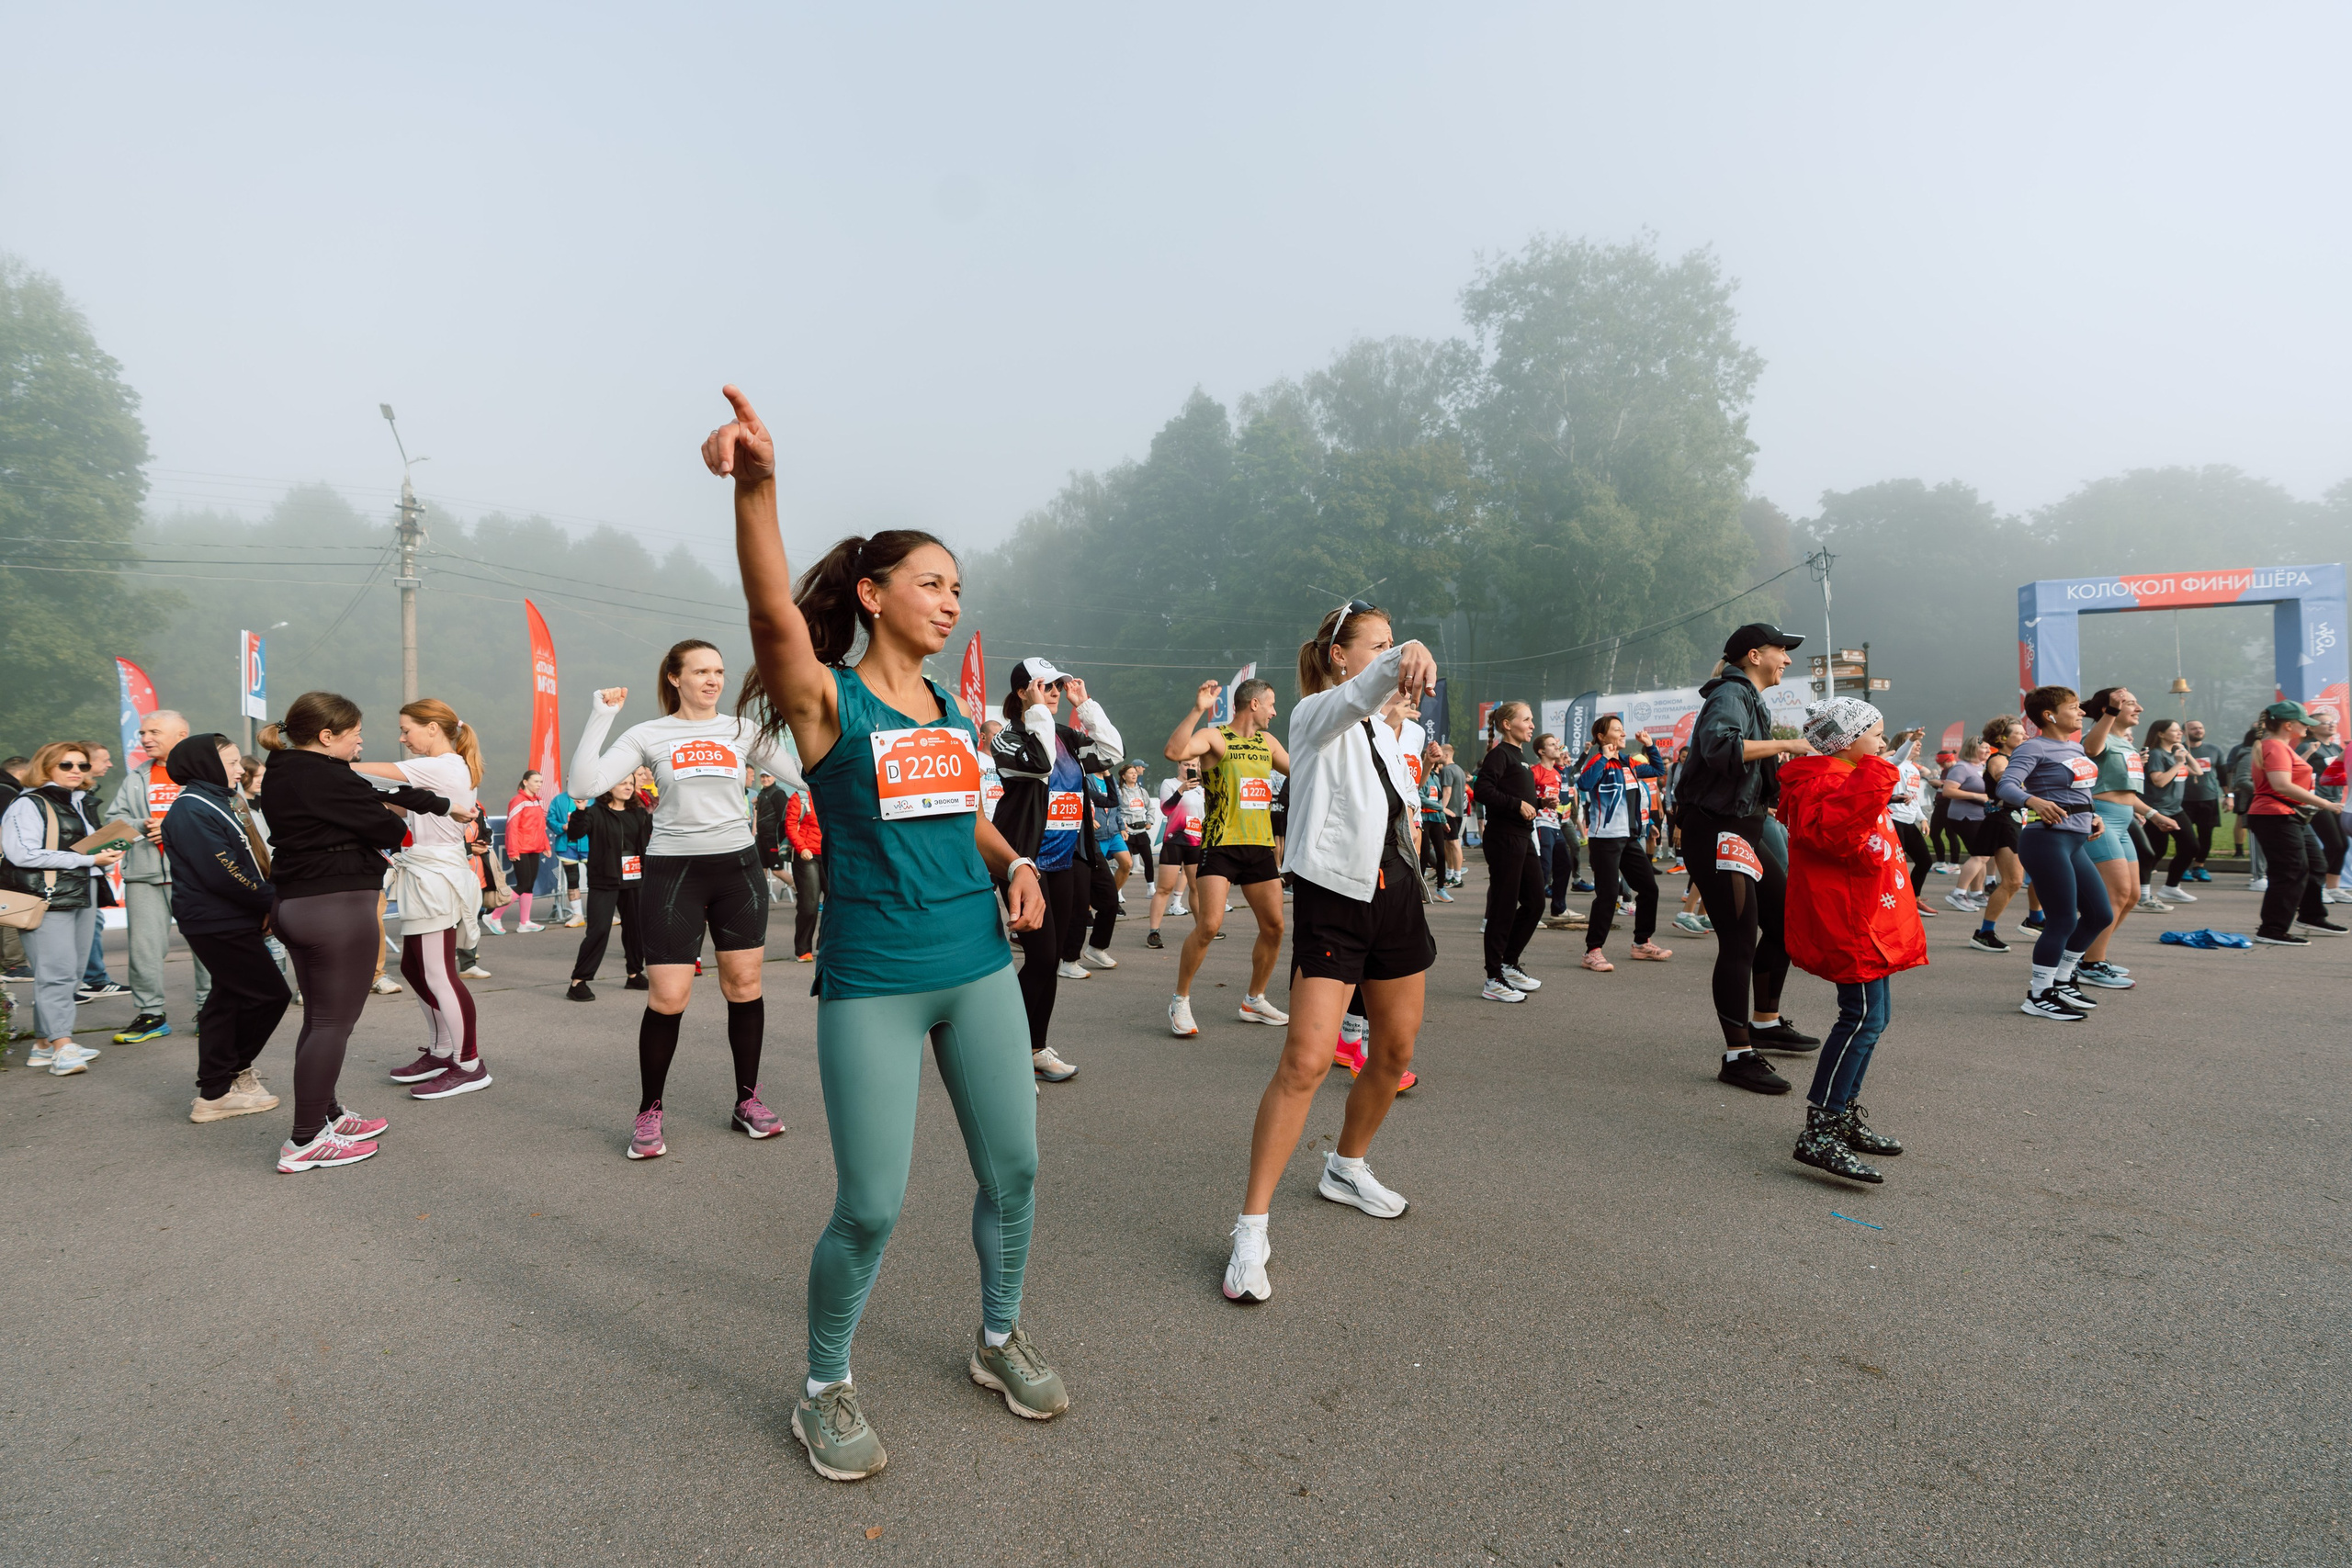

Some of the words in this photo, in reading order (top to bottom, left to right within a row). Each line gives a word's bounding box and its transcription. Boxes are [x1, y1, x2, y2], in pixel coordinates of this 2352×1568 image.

[2066, 578, 2176, 601] КОЛОКОЛ
[2180, 569, 2312, 592] ФИНИШЁРА
[1654, 698, 1683, 706] ЭВОКОМ
[1572, 705, 1584, 755] ЭВОКОМ
[686, 750, 723, 761] 2036
[888, 765, 899, 780] D
[905, 754, 962, 780] 2260
[1250, 787, 1266, 797] 2272
[933, 797, 960, 807] ЭВОКОМ
[1059, 804, 1078, 815] 2135
[1732, 844, 1755, 863] 2236
[215, 851, 252, 887] LeMieux
